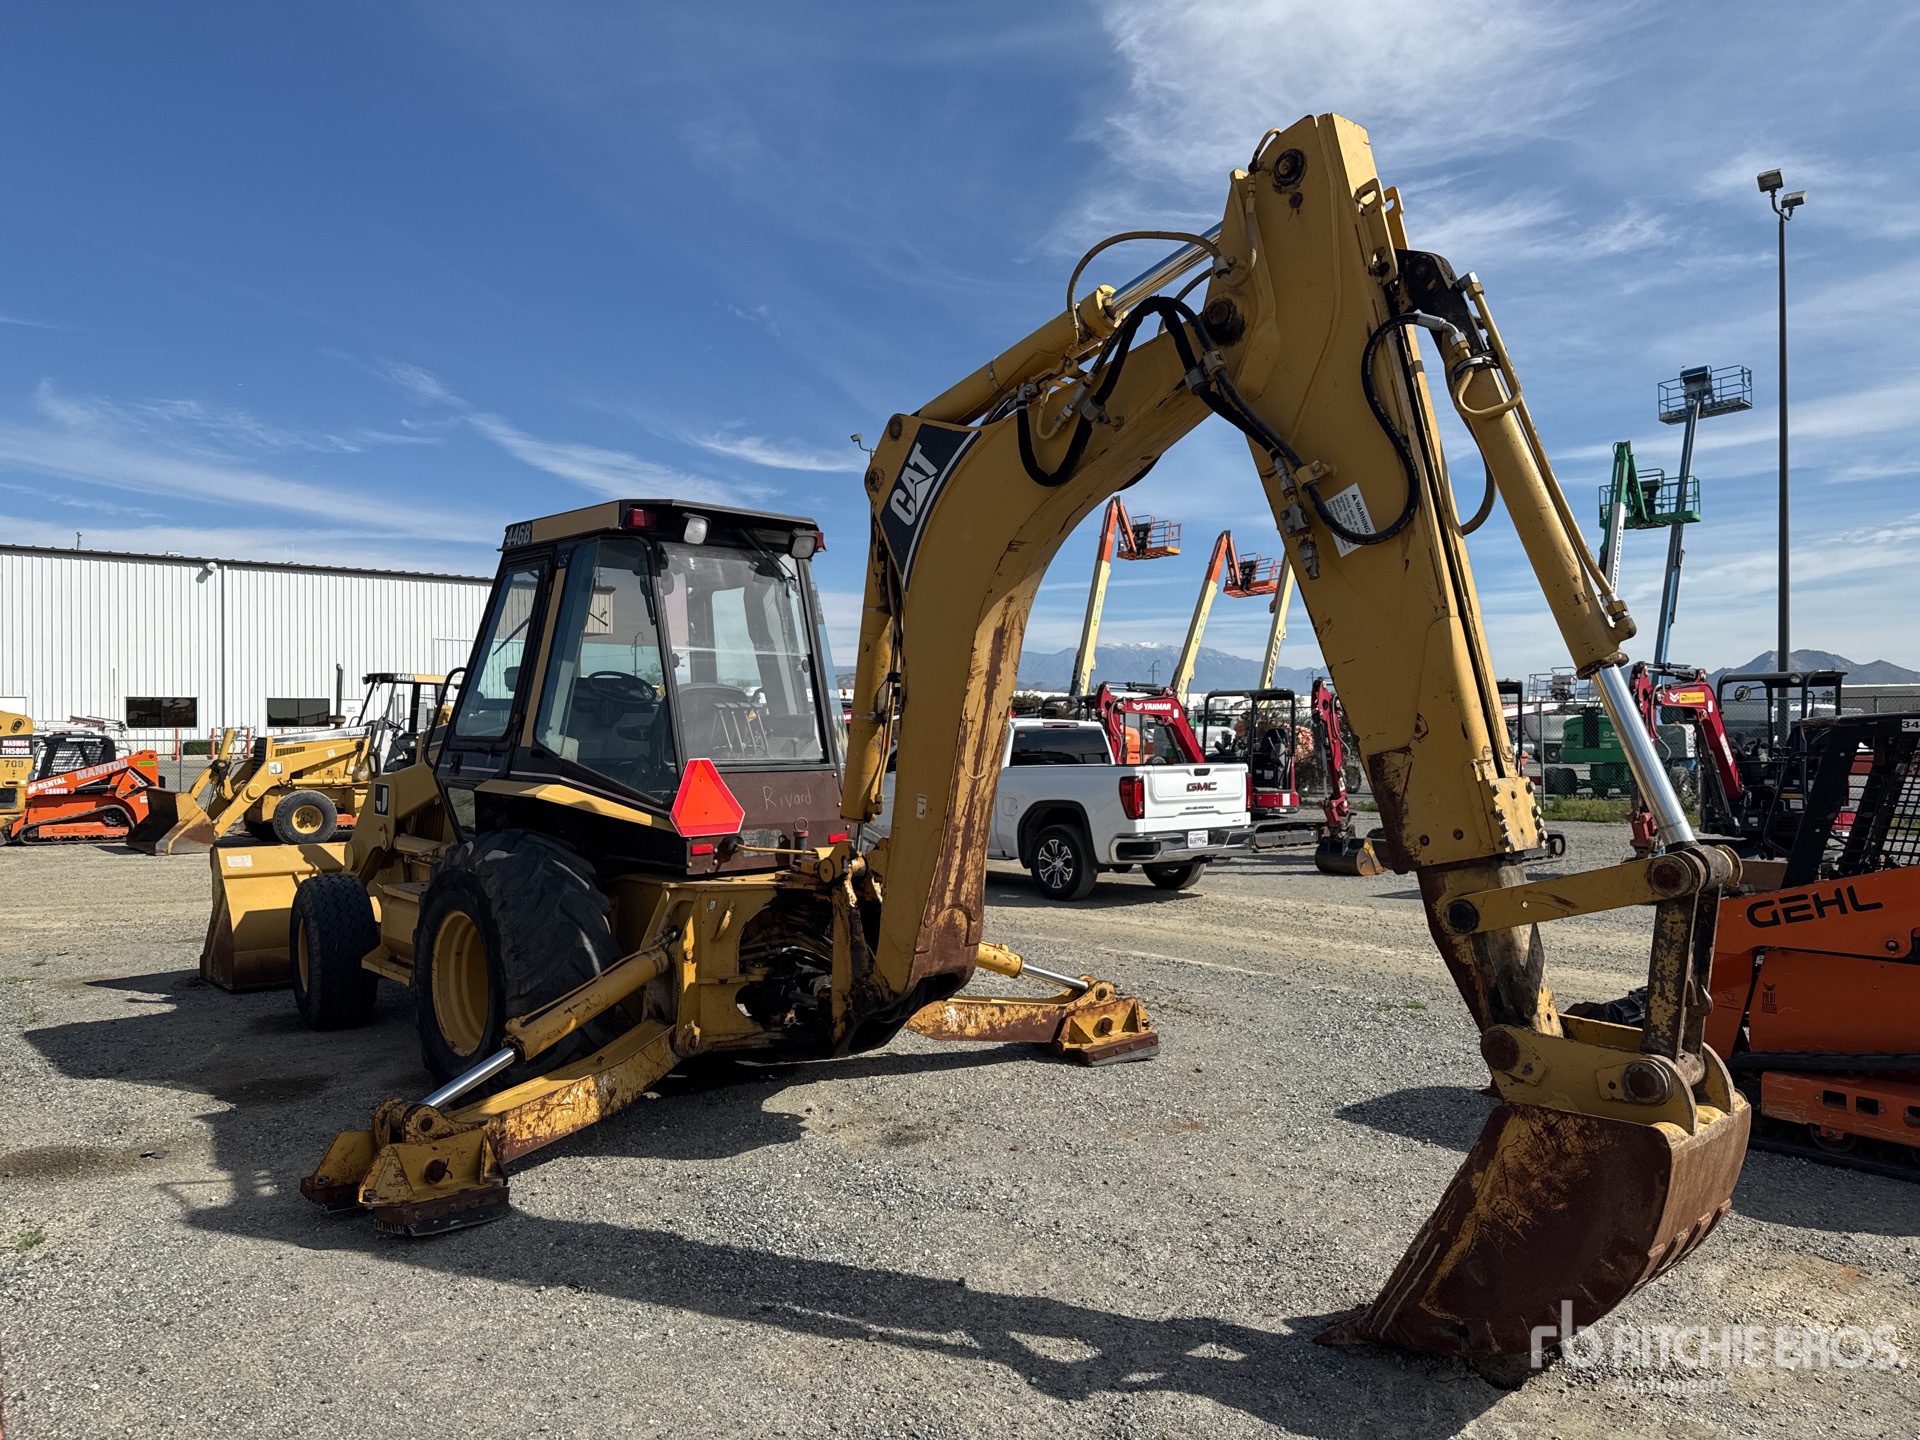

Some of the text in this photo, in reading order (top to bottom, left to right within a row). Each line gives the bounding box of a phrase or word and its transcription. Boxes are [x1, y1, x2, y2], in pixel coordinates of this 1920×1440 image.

[890, 442, 938, 526] CAT
[1355, 500, 1370, 534] WARNING
[506, 524, 532, 546] 446B
[395, 673, 414, 681] 446B
[5, 760, 24, 768] 709
[76, 759, 128, 780] MANITOU
[38, 777, 68, 790] RENTAL
[1186, 782, 1217, 792] GMC
[762, 786, 812, 810] Rivard
[1747, 885, 1884, 929] GEHL
